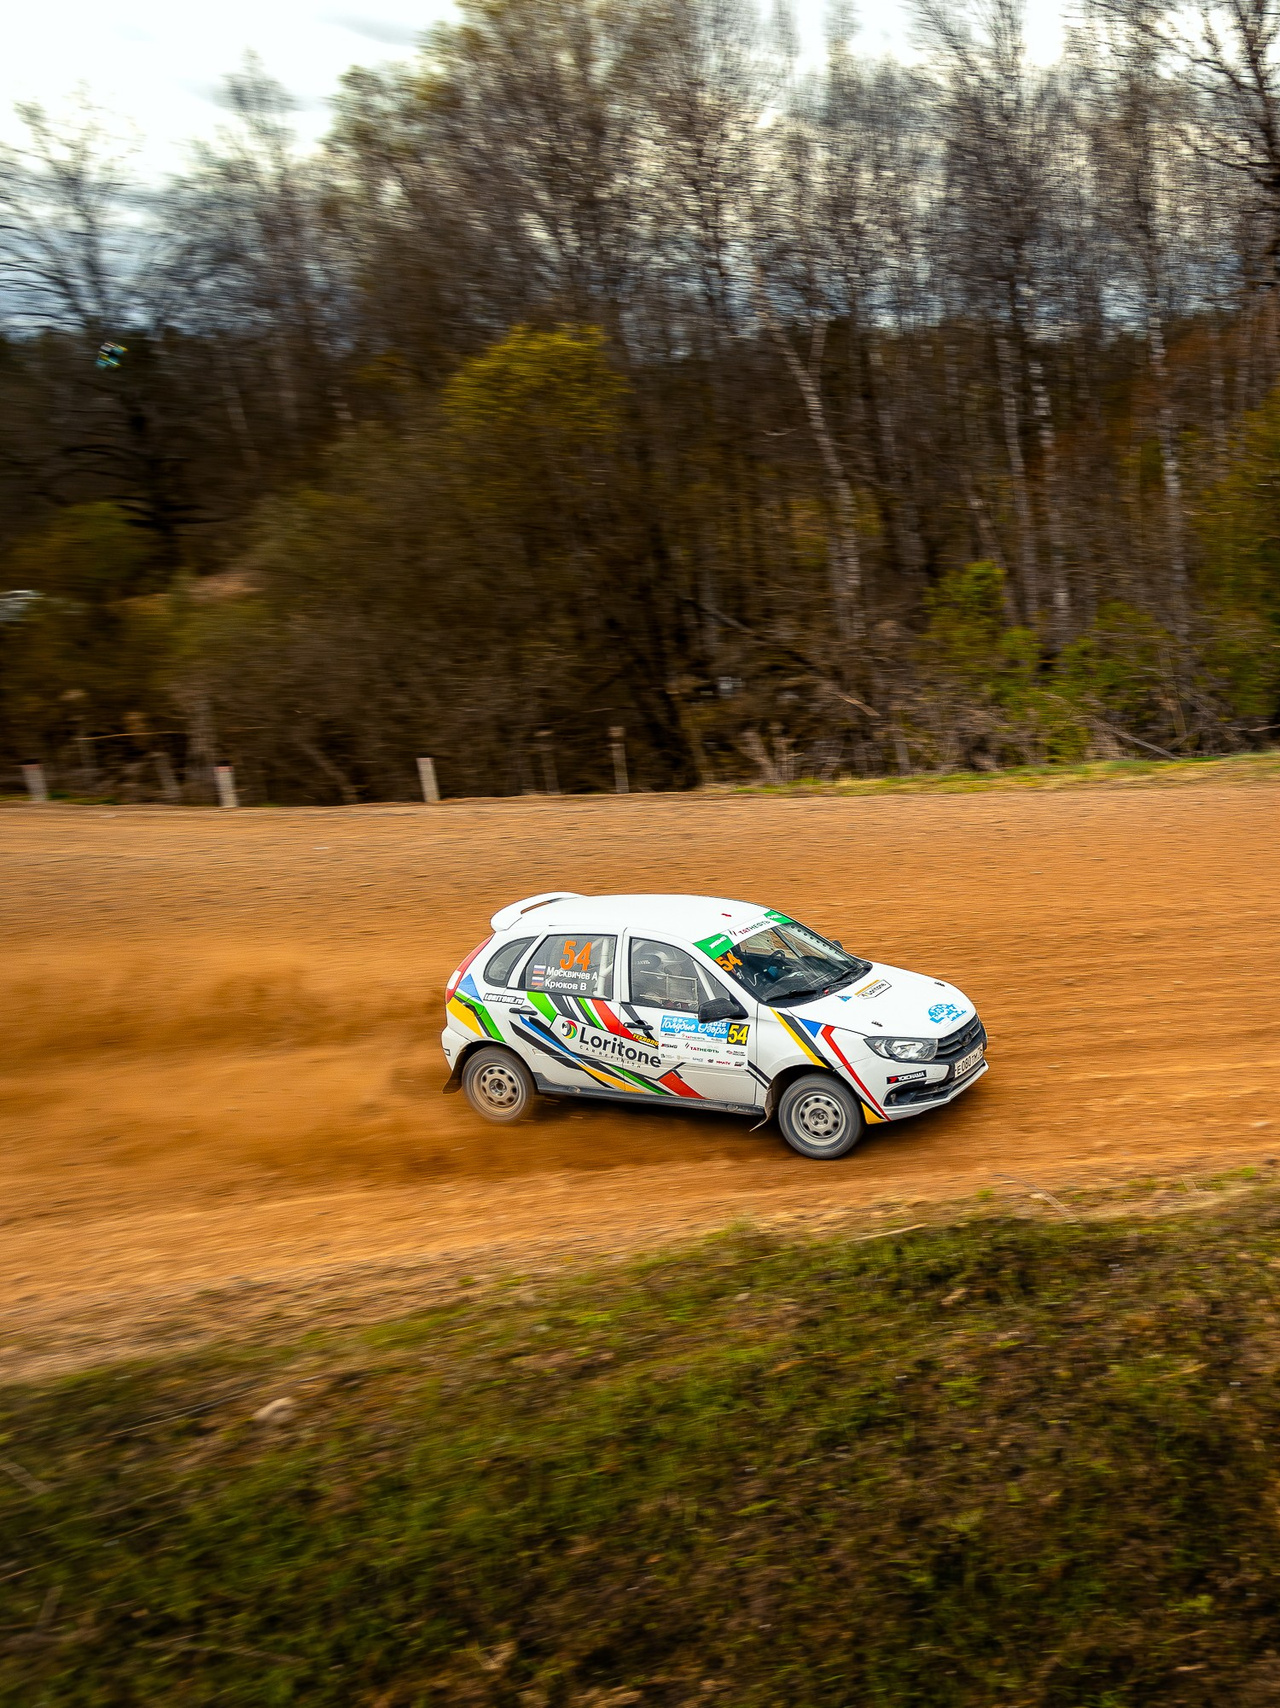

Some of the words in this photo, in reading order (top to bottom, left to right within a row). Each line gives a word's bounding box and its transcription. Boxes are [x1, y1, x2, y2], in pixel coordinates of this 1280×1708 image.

[560, 940, 592, 972] 54
[715, 952, 743, 971] 54
[546, 966, 590, 980] Москвичев
[545, 979, 578, 990] Крюков
[661, 1017, 695, 1033] Голубые
[697, 1021, 727, 1037] Озера
[727, 1024, 749, 1045] 54
[579, 1027, 662, 1068] Loritone
[690, 1046, 720, 1054] ТАТНЕФТЬ
[898, 1071, 925, 1082] YOKOHAMA
